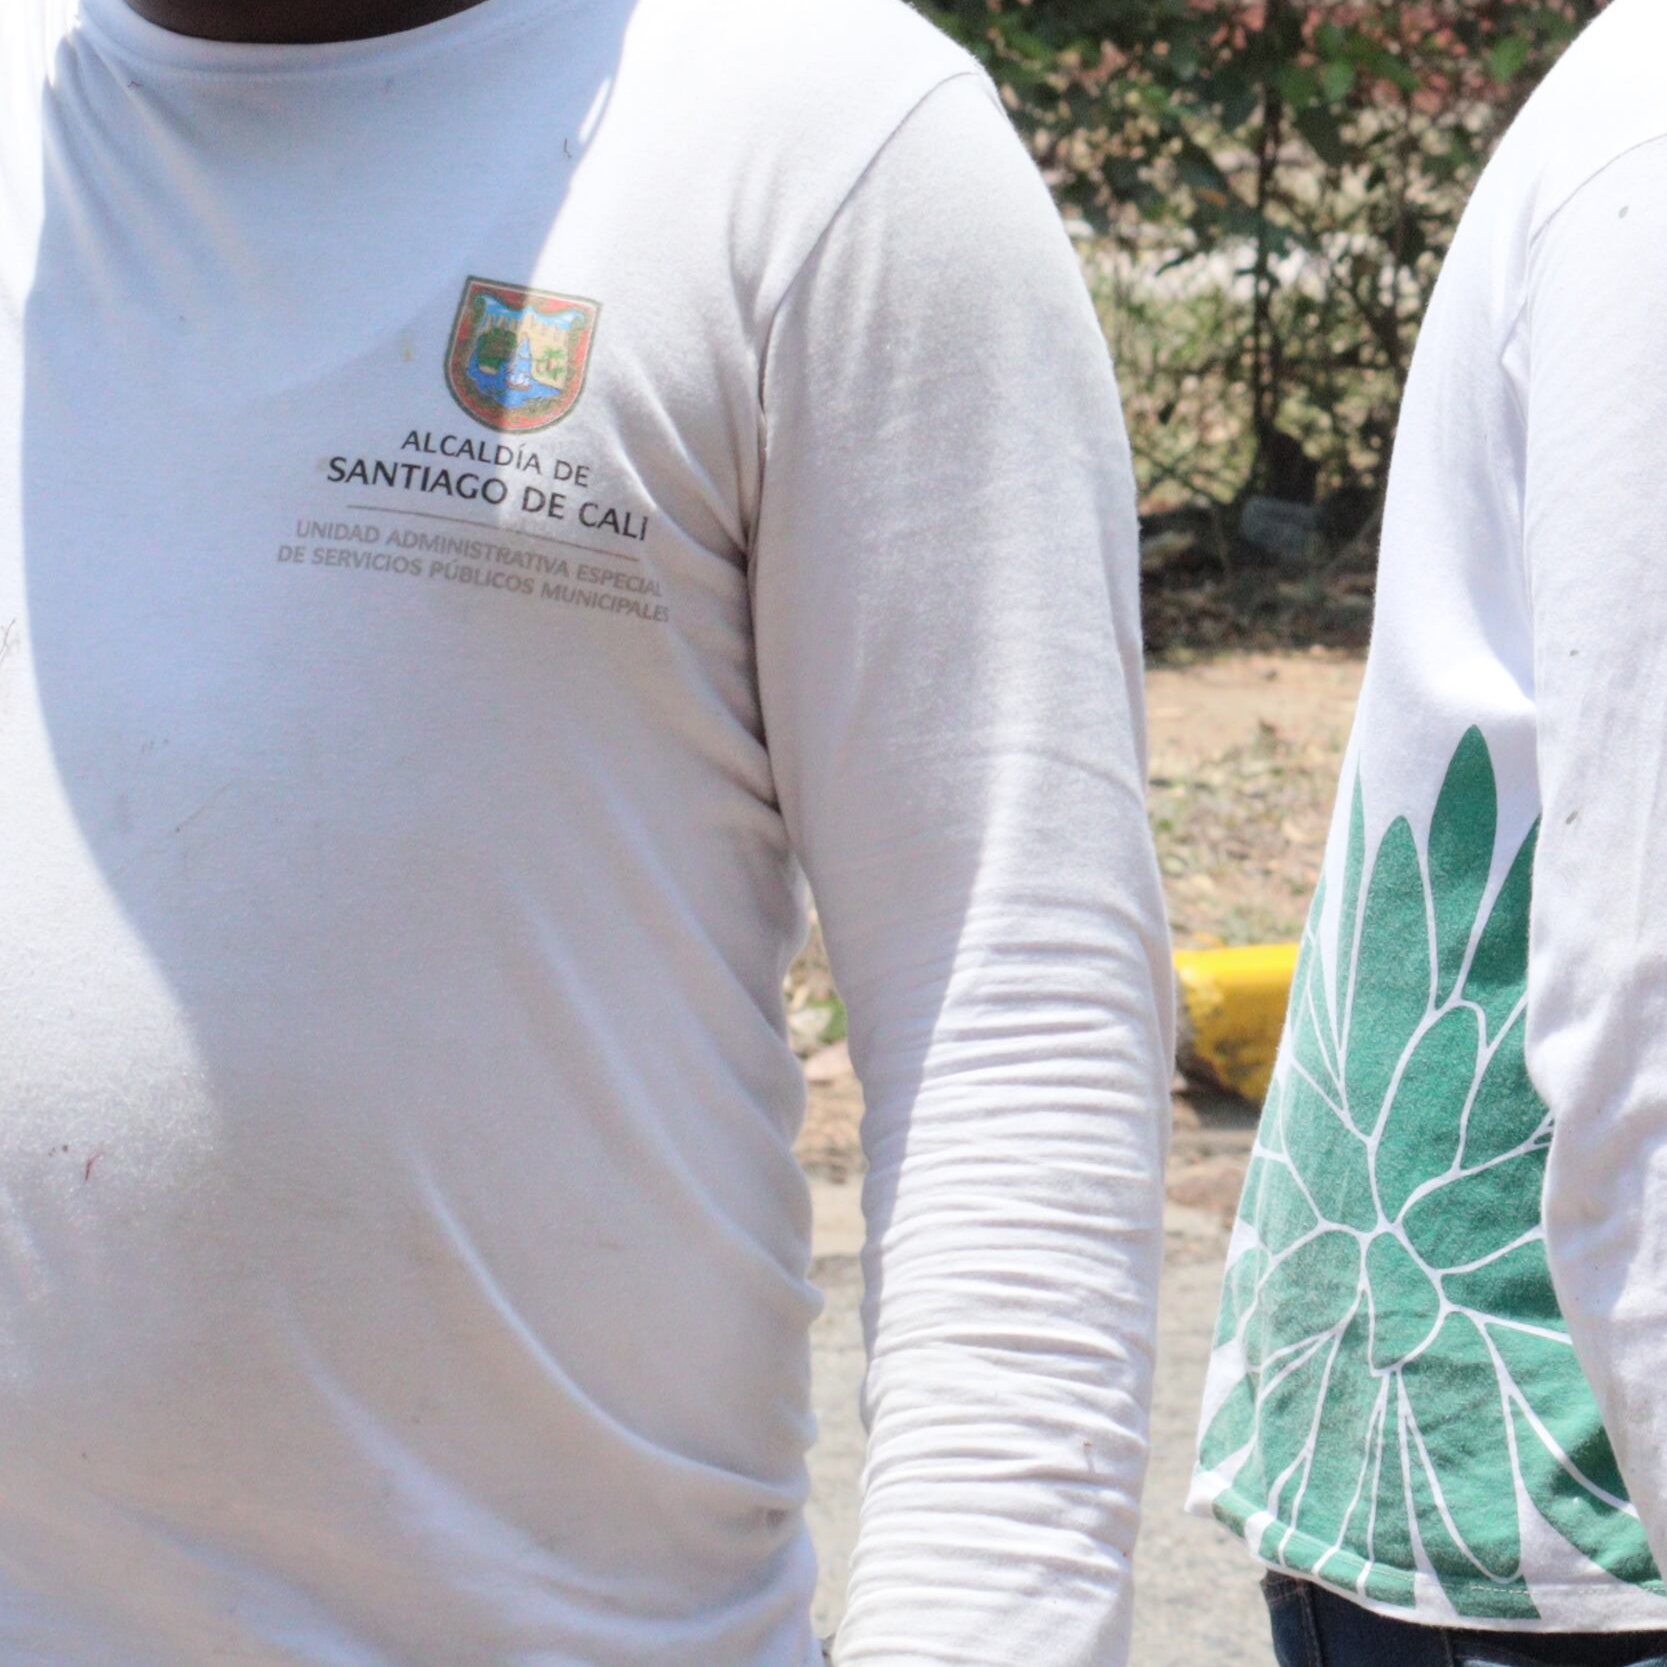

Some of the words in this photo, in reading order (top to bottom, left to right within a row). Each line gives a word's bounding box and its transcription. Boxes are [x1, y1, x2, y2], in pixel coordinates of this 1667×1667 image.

[401, 430, 542, 475] ALCALDÍA
[553, 460, 591, 488] DE
[327, 456, 508, 505] SANTIAGO
[522, 485, 565, 520] DE
[579, 501, 649, 541] CALI
[277, 545, 306, 564] DE
[311, 546, 423, 577] SERVICIOS
[429, 558, 535, 596] PÚBLICOS
[540, 581, 670, 623] MUNICIPALES
[296, 519, 380, 544] UNIDAD
[386, 529, 570, 578] ADMINISTRATIVA
[576, 563, 663, 597] ESPECIAL
